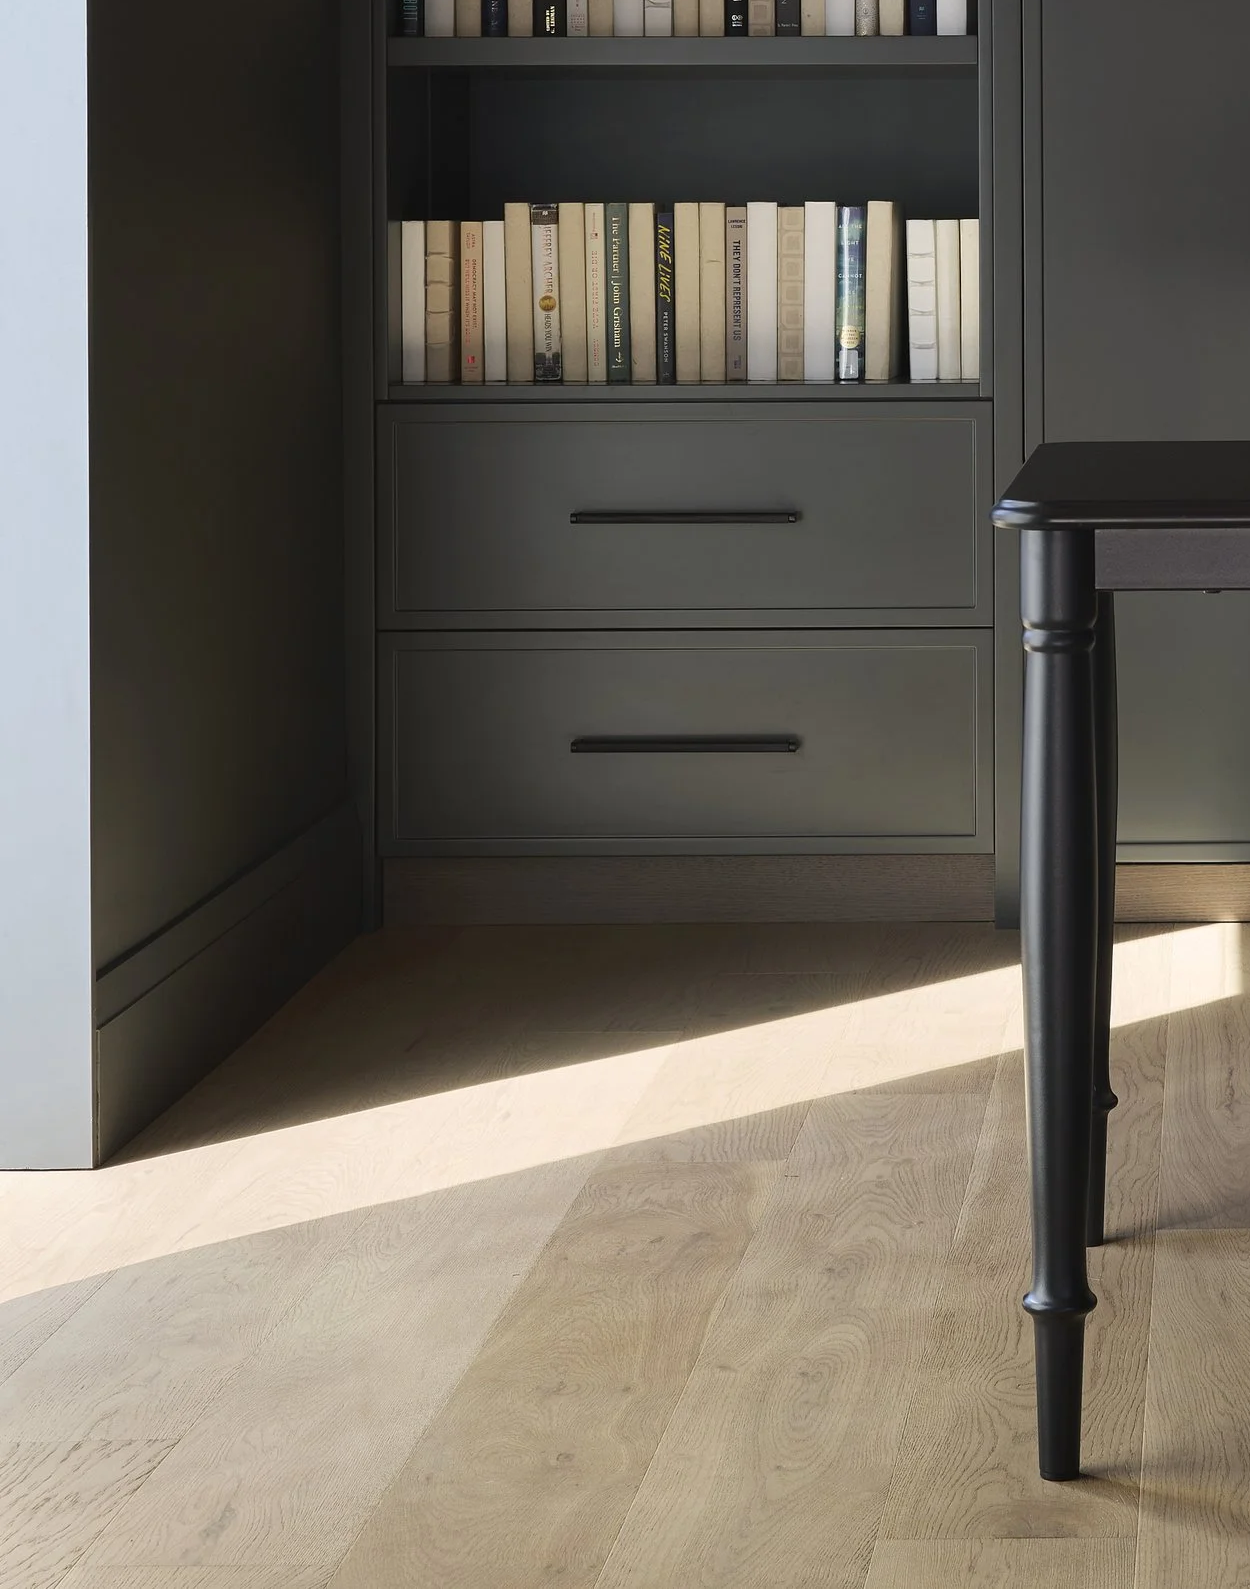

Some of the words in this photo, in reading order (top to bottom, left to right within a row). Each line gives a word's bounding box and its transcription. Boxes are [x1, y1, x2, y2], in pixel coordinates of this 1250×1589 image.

[612, 217, 620, 235] The
[612, 238, 620, 273] Partner
[732, 240, 740, 261] THEY
[732, 263, 740, 285] DON'T
[611, 281, 620, 304] John
[733, 287, 741, 329] REPRESENT
[613, 307, 622, 348] Grisham
[734, 330, 742, 341] US
